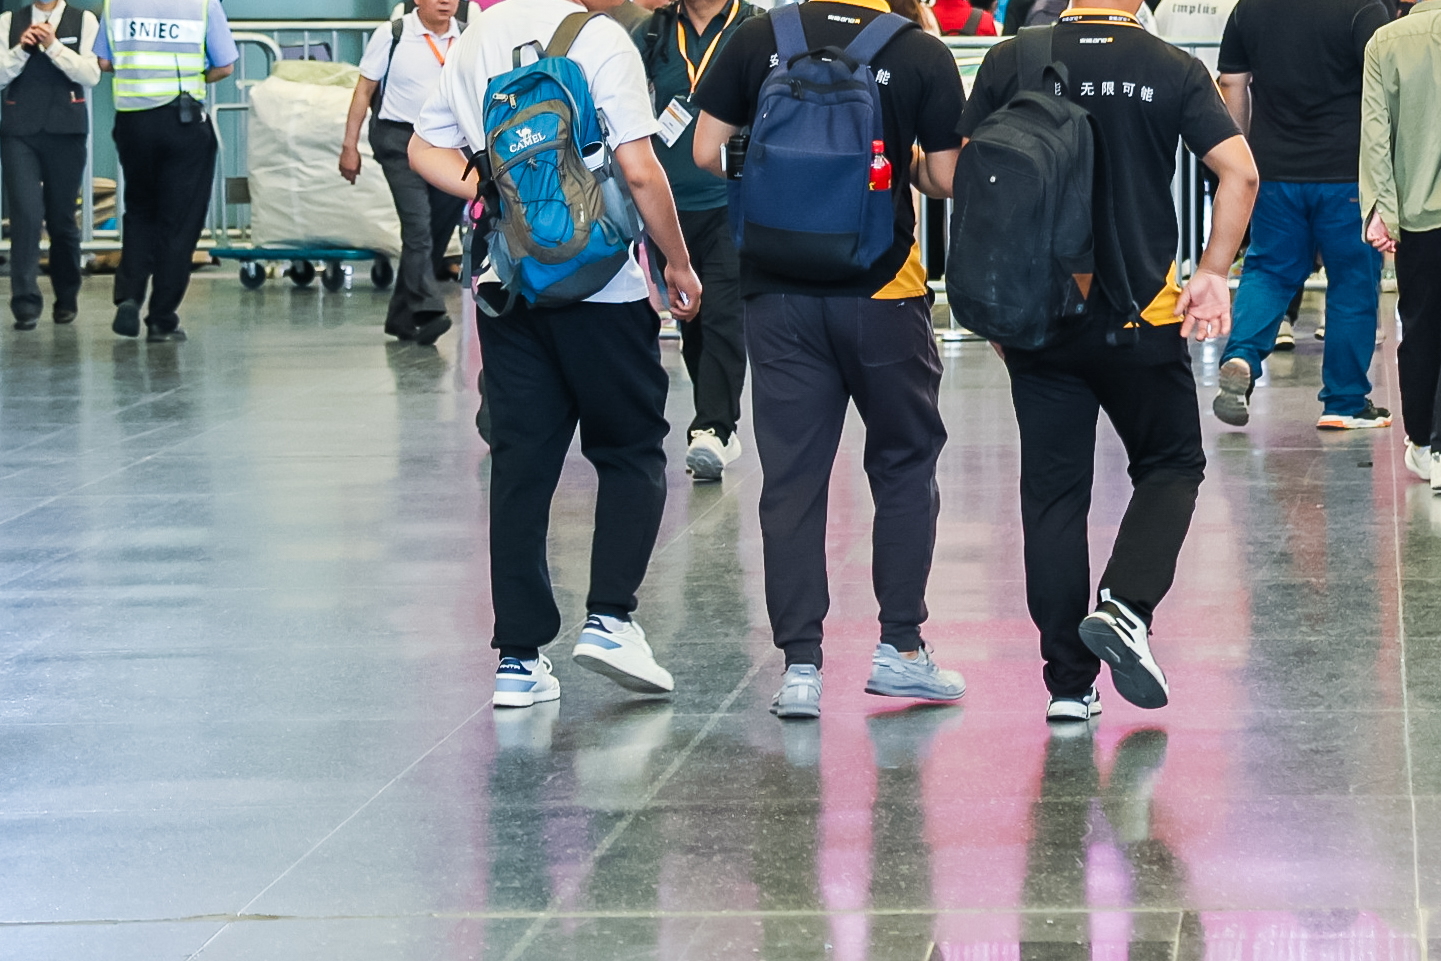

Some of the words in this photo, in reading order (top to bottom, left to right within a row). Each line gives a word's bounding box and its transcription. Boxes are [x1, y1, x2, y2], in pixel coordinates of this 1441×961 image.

[129, 20, 180, 39] SNIEC
[1080, 81, 1154, 103] 无限可能
[509, 132, 547, 153] CAMEL
